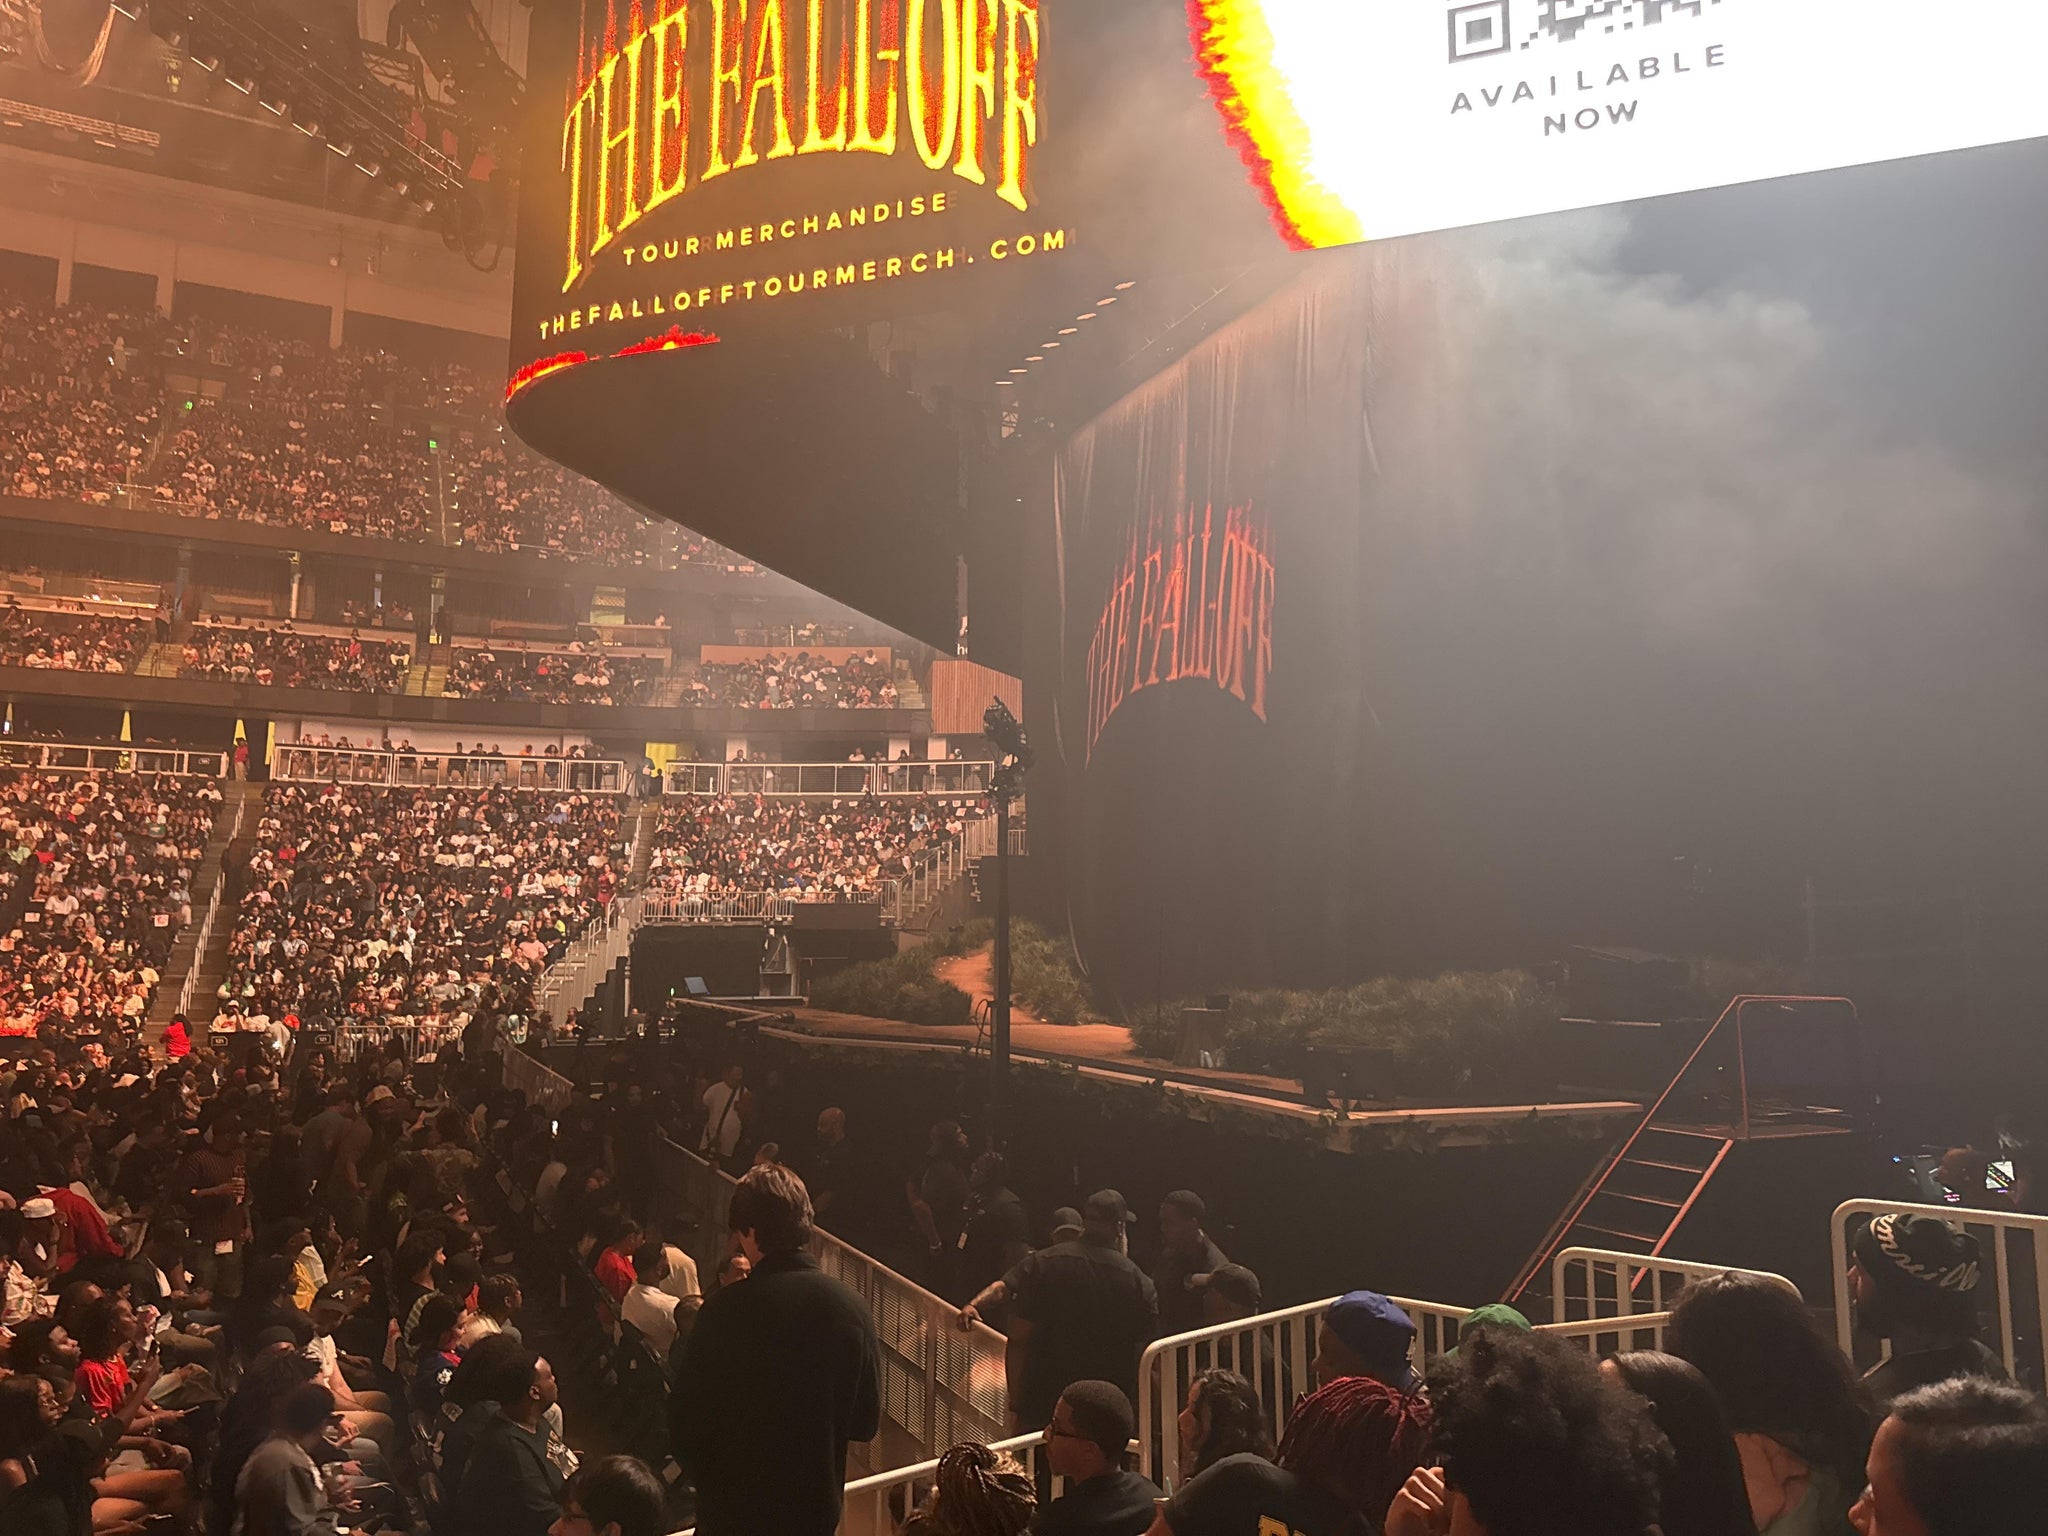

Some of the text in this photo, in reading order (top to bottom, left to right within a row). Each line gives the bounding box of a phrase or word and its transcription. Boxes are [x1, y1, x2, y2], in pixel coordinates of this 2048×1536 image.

[1450, 43, 1726, 115] AVAILABLE
[562, 8, 691, 293] THE
[1543, 99, 1639, 137] NOW
[622, 191, 949, 267] TOUR MERCHANDISE
